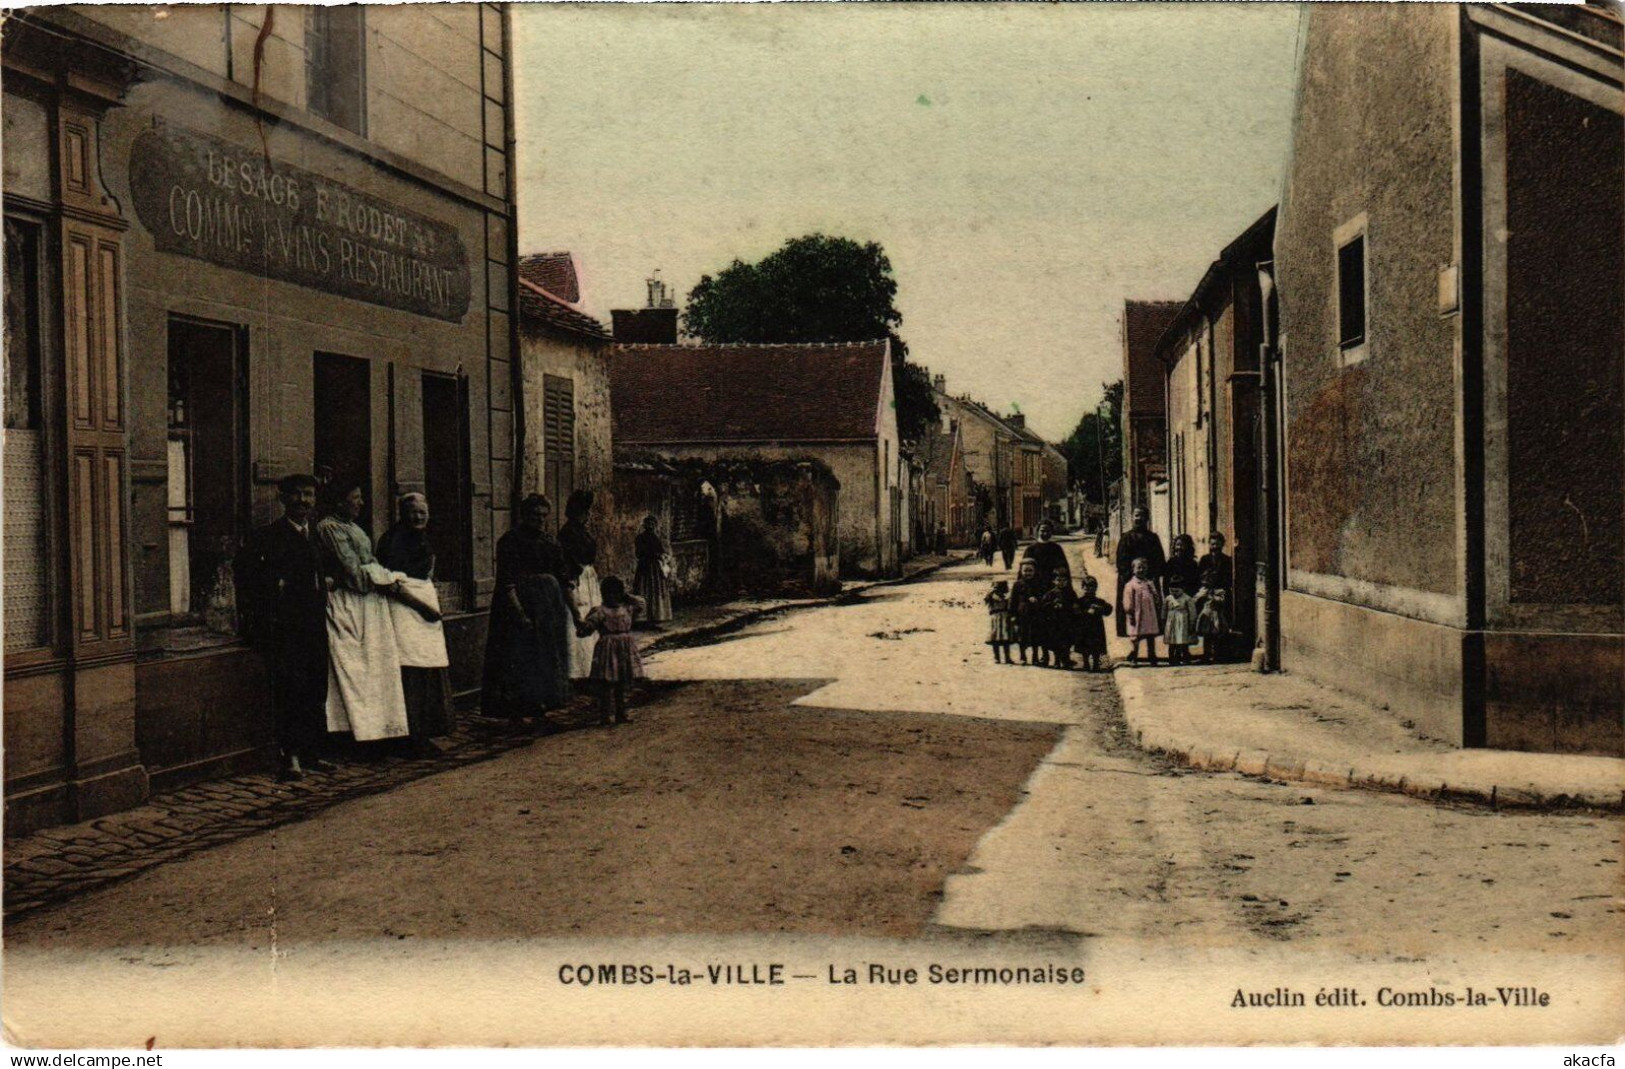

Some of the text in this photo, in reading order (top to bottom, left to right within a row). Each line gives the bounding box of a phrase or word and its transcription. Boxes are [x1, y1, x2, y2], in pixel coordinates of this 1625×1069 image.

[208, 150, 300, 211] LESAGE
[277, 217, 331, 274] VINS
[339, 236, 452, 307] RESTAURANT
